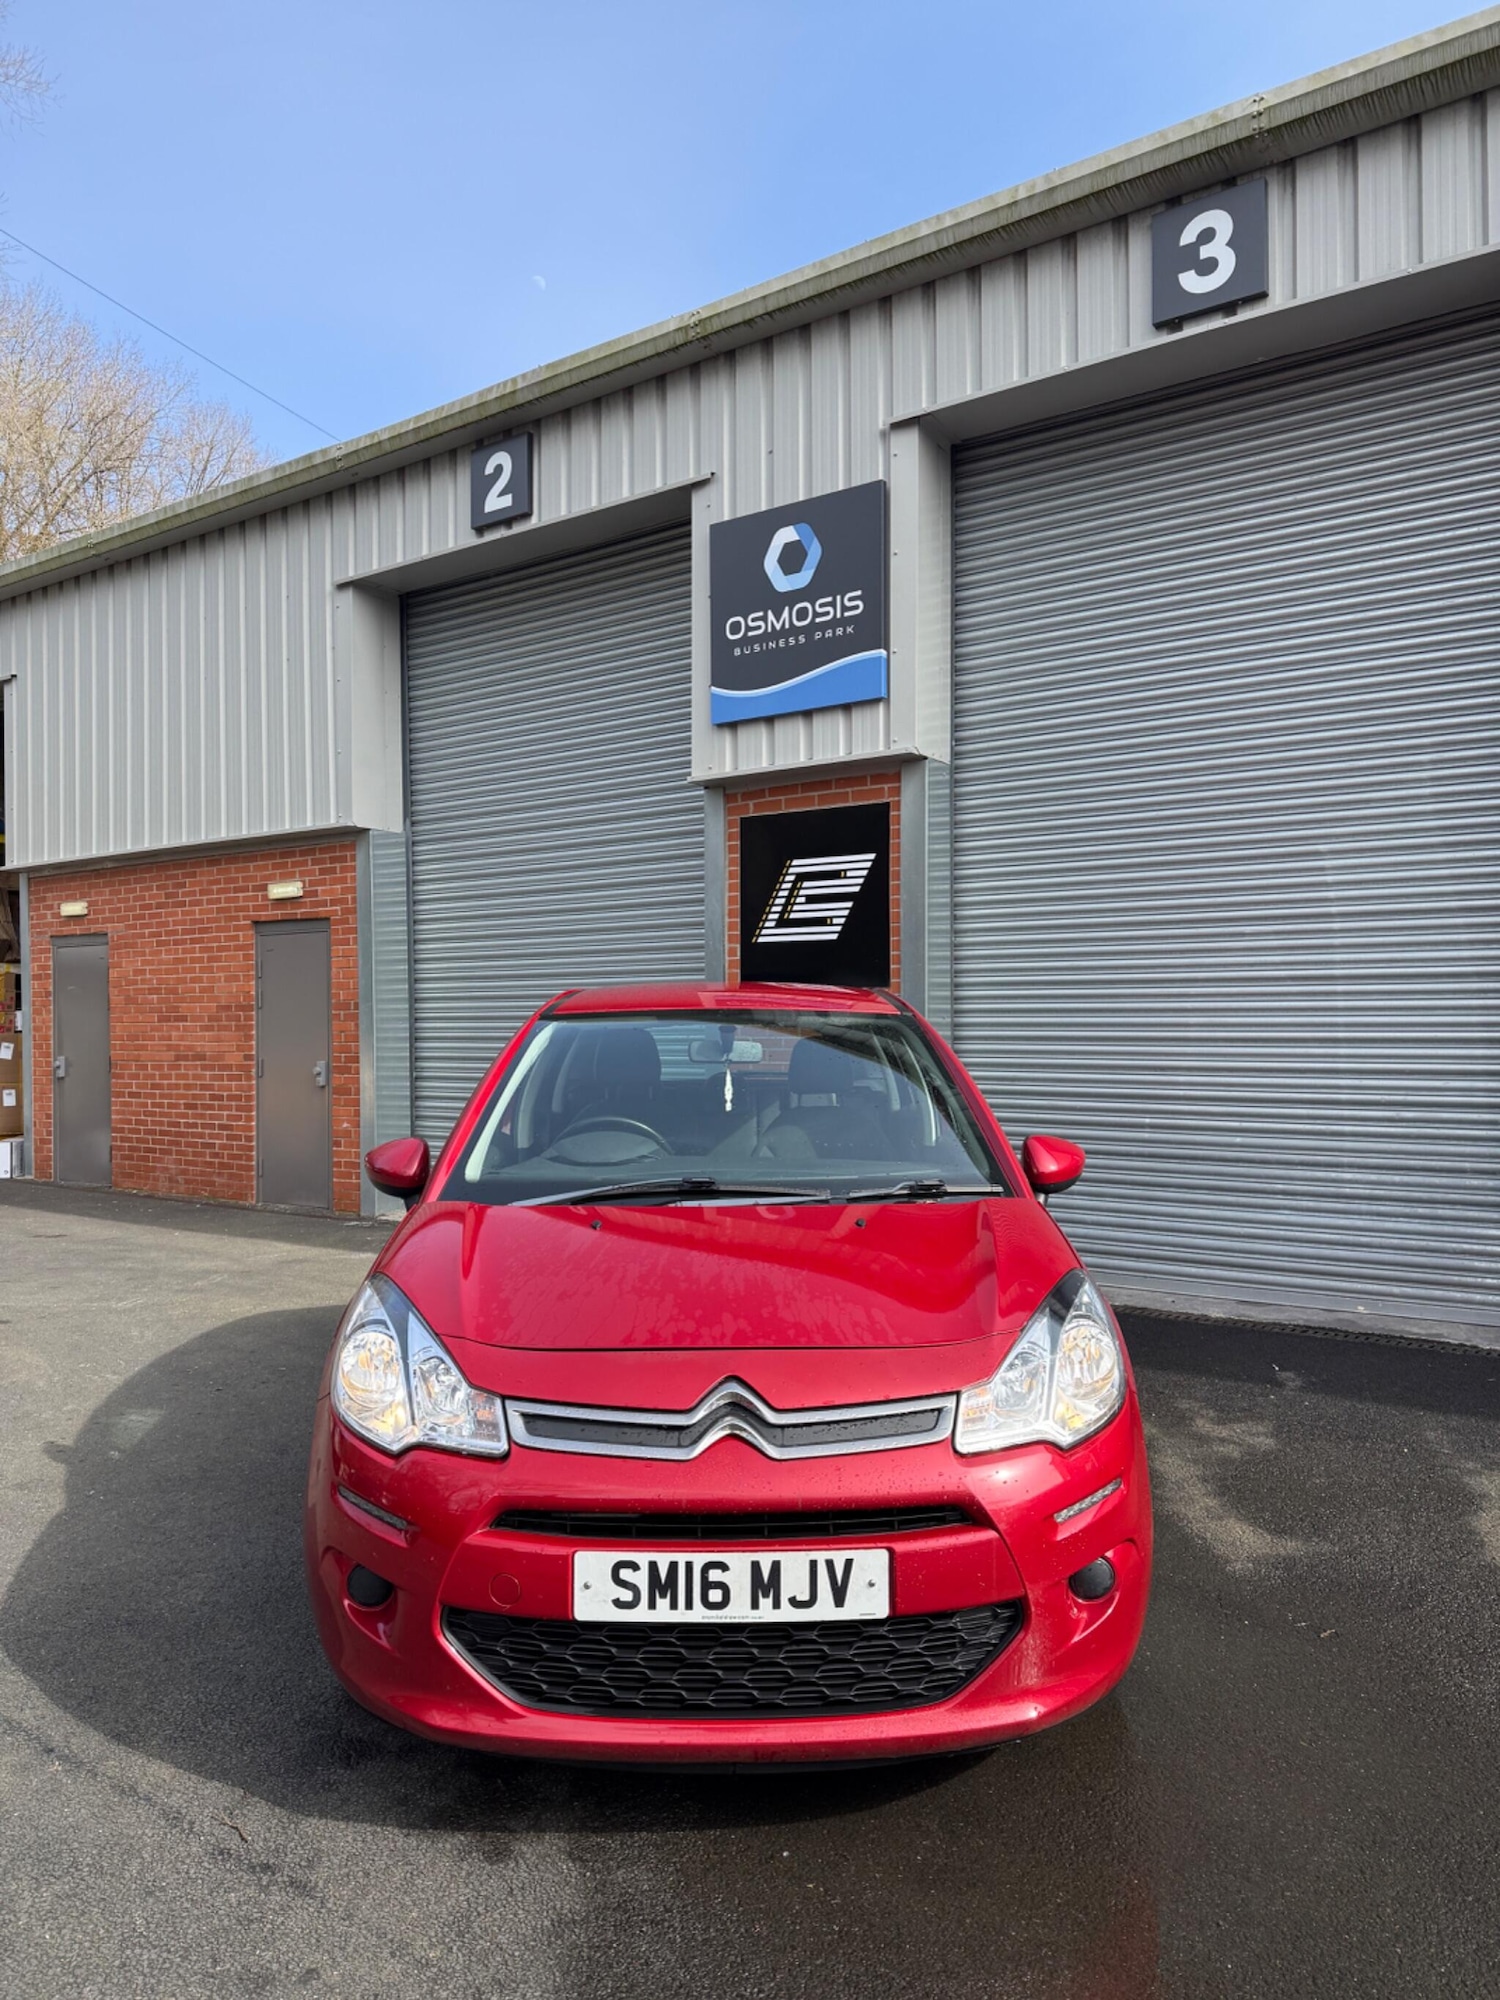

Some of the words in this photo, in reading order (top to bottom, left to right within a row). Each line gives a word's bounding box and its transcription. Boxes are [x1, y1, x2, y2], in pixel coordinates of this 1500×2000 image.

[1177, 208, 1238, 294] 3
[483, 451, 513, 514] 2
[725, 589, 865, 640] OSMOSIS
[733, 634, 806, 657] BUSINESS
[814, 624, 855, 640] PARK
[611, 1559, 731, 1611] SM16
[750, 1558, 854, 1611] MJV
